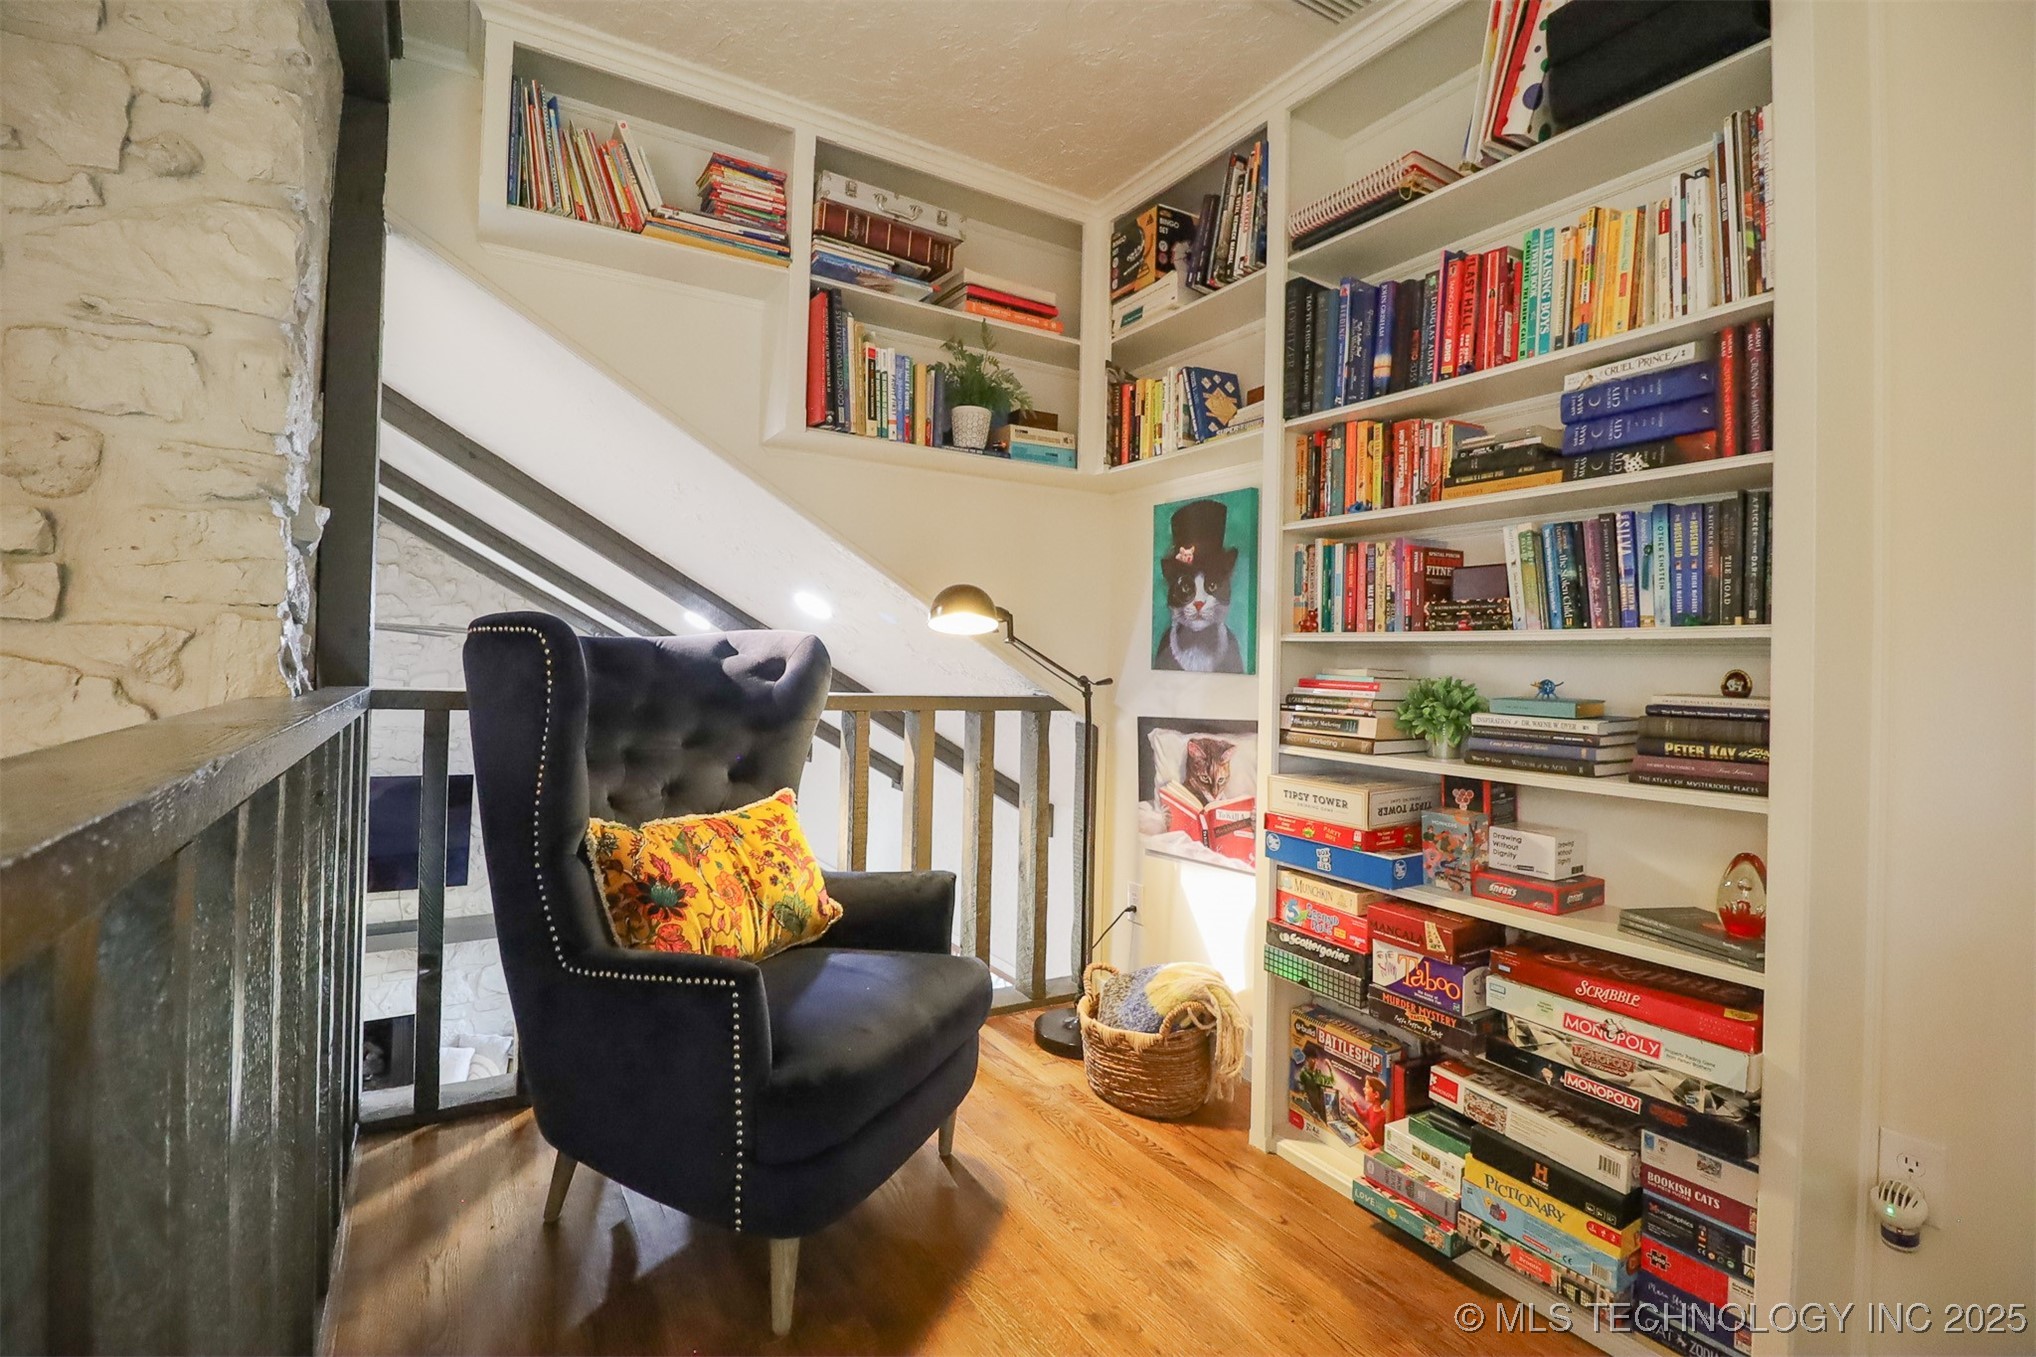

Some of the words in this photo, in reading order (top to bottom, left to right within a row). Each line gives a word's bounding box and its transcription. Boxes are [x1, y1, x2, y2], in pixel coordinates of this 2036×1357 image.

[1159, 218, 1179, 228] BINGO
[1159, 226, 1169, 234] SET
[1531, 248, 1539, 275] TWEEN
[1465, 264, 1475, 294] LAST
[1541, 248, 1553, 299] RAISING
[1380, 285, 1388, 303] JOHN
[1530, 276, 1538, 298] BOOK
[1379, 305, 1387, 337] GRISHAM
[1427, 296, 1437, 340] DOUGLAS
[1463, 298, 1472, 330] HILL
[1540, 301, 1551, 334] BOYS
[1446, 329, 1453, 337] OF
[1444, 339, 1452, 362] ADHD
[1604, 362, 1635, 376] CRUEL
[1637, 353, 1671, 369] PRINCE
[1750, 357, 1759, 390] CROWN
[1612, 386, 1621, 407] CITY
[1615, 418, 1623, 439] CITY
[1750, 399, 1760, 441] MIDNIGHT
[1615, 452, 1623, 472] CITY
[1616, 521, 1631, 556] SILVA
[1674, 523, 1683, 558] HOUSEMAID
[1690, 520, 1699, 556] HOUSEMAID
[1426, 566, 1455, 576] FITNE
[1559, 554, 1568, 568] the
[1563, 596, 1573, 618] Child
[1476, 716, 1511, 724] INSPIRATION
[1532, 720, 1552, 728] WAYNE
[1309, 737, 1337, 747] Marketing
[1664, 742, 1705, 755] PETER
[1709, 745, 1736, 757] KAY
[1652, 775, 1672, 784] ATLAS
[1687, 780, 1730, 791] MYSTERIOUS
[1733, 785, 1759, 793] PLACES
[1284, 790, 1310, 801] TIPSY
[1313, 795, 1349, 809] TOWER
[1378, 805, 1407, 816] TOWER
[1323, 826, 1341, 837] PARTY
[1493, 832, 1522, 844] Drawing
[1493, 841, 1519, 851] Without
[1493, 849, 1517, 860] Dignity
[1294, 878, 1333, 901] MUNCHKIN
[1369, 920, 1425, 944] MANCALA
[1288, 933, 1350, 963] Scattergories
[1398, 954, 1461, 1000] Taboo
[1574, 980, 1641, 1007] SCRABBLE
[1382, 993, 1416, 1013] MURDER
[1419, 1006, 1457, 1028] MYSTERY
[1565, 1016, 1660, 1055] MONOPOLY
[1318, 1029, 1380, 1069] BATTLESHIP
[1567, 1077, 1638, 1109] MONOPOLY
[1535, 1162, 1548, 1182] H
[1354, 1189, 1376, 1206] LOVE
[1484, 1173, 1566, 1224] PICTIONARY
[1647, 1171, 1692, 1197] BOOKISH
[1694, 1191, 1721, 1210] CATS
[1645, 1318, 1674, 1342] CAT
